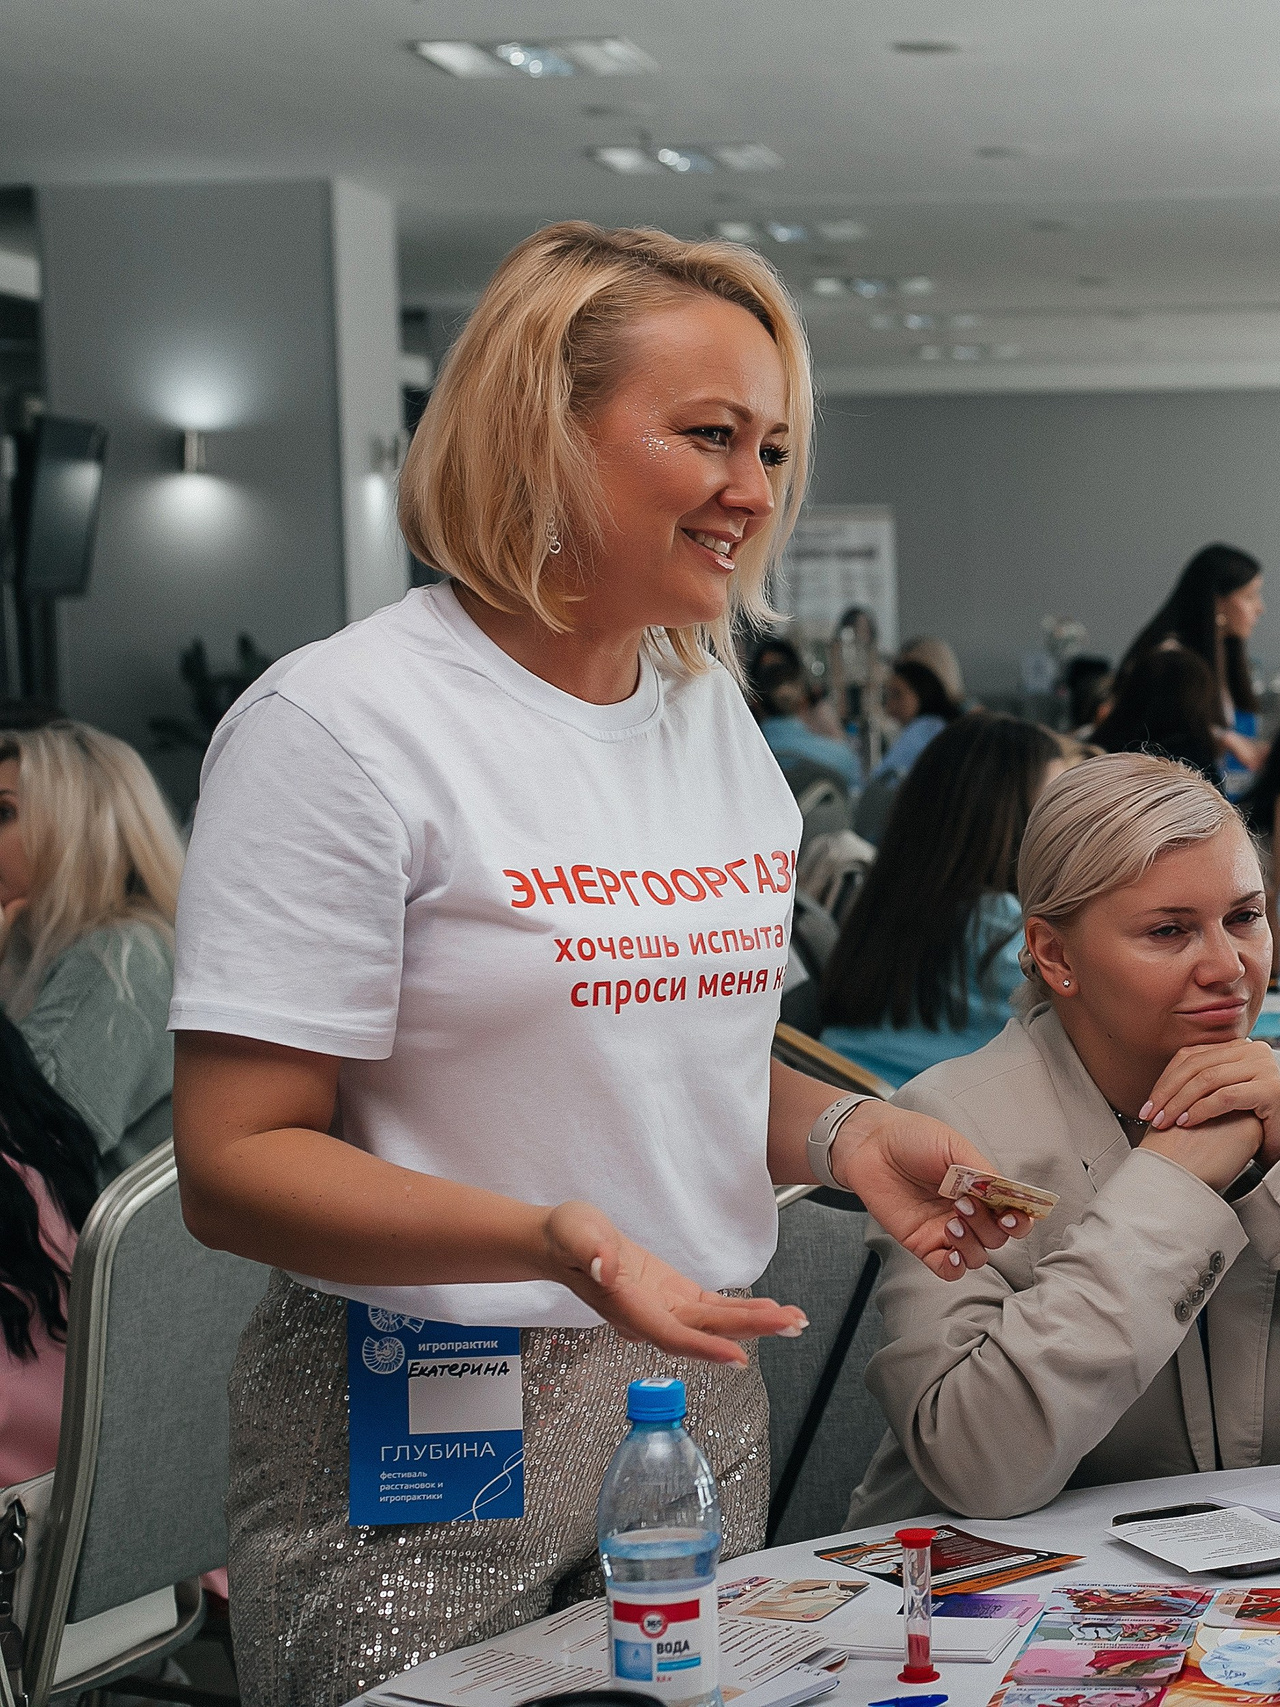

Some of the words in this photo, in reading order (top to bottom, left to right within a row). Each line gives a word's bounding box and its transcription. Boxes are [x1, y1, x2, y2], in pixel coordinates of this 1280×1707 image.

[554, 936, 680, 963] хочешь
[688, 924, 787, 956] испыта
[570, 976, 687, 1014] спроси
[698, 968, 769, 999] меня
[418, 1339, 499, 1353] игропрактик
[381, 1441, 496, 1462] ГЛУБИНА
[379, 1471, 428, 1481] фестиваль
[379, 1483, 436, 1493] расстановок
[379, 1493, 443, 1503] игропрактики
[656, 1640, 690, 1656] ВОДА
